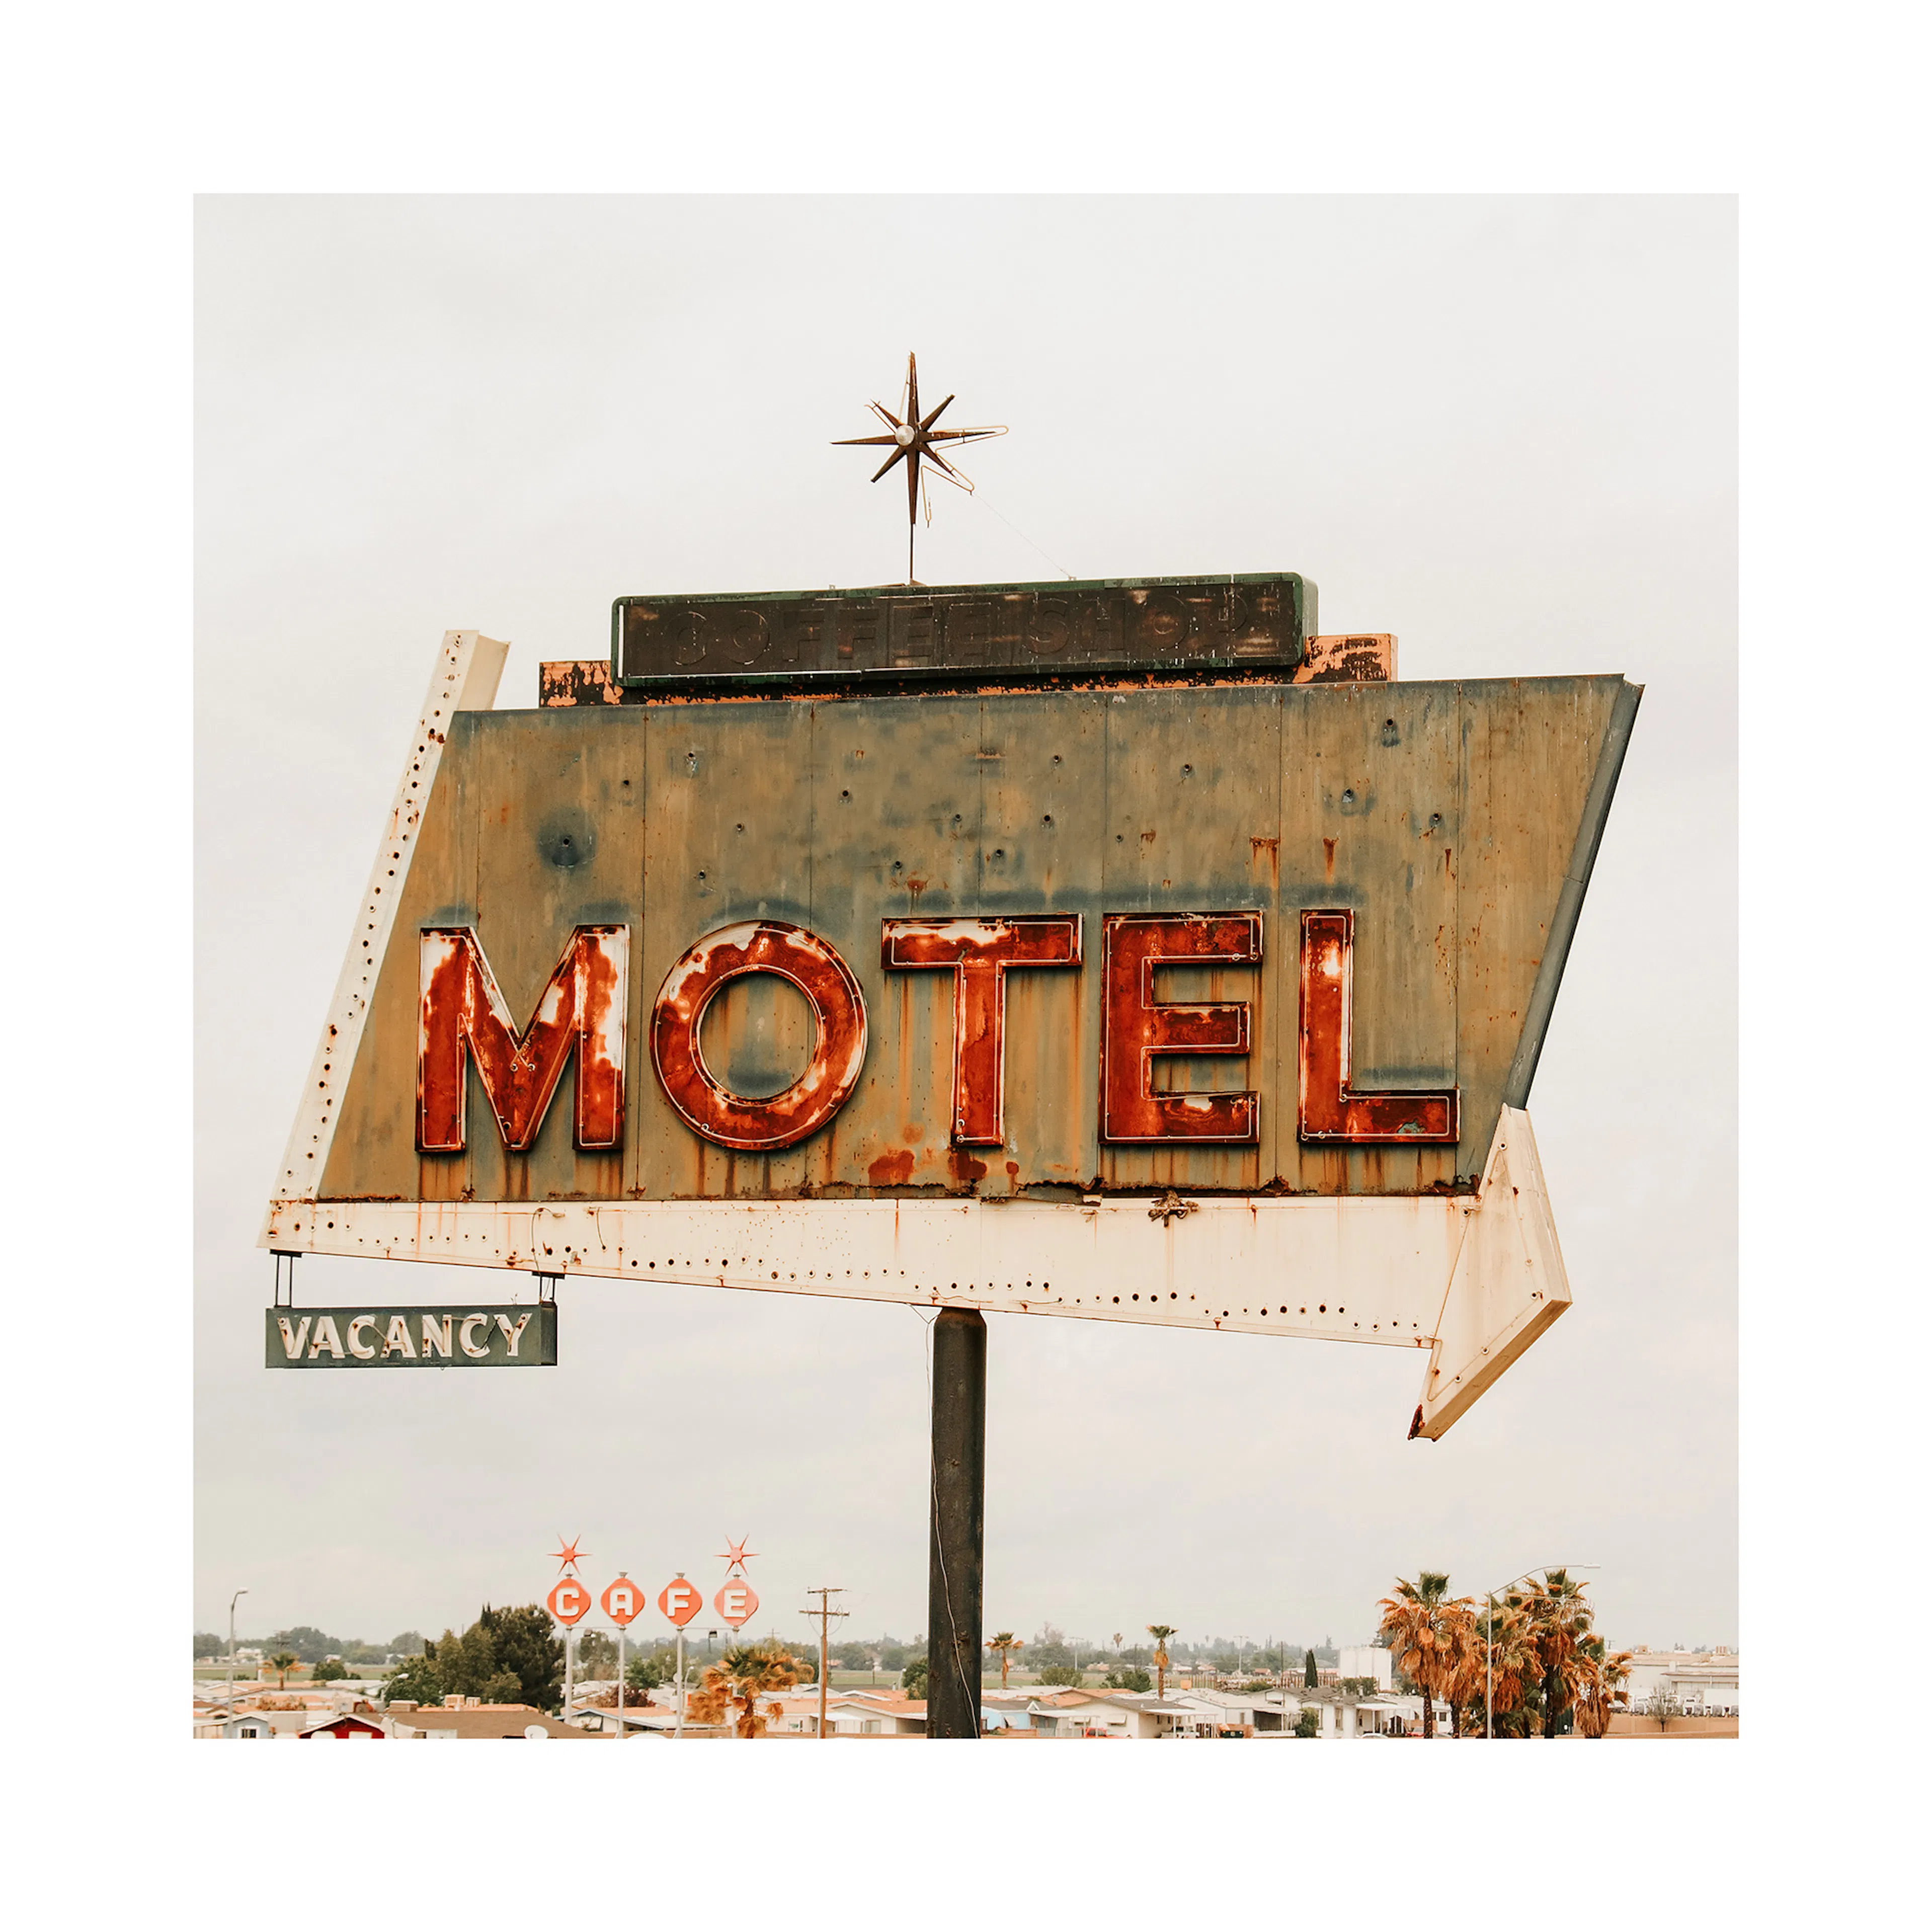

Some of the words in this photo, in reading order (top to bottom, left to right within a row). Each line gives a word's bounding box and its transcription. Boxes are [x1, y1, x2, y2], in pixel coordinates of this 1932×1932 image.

[662, 602, 991, 666] COFFEE
[1023, 592, 1249, 655] SHOP
[415, 909, 1460, 1152] MOTEL
[277, 1313, 532, 1359] VACANCY
[555, 1587, 747, 1618] CAFE
